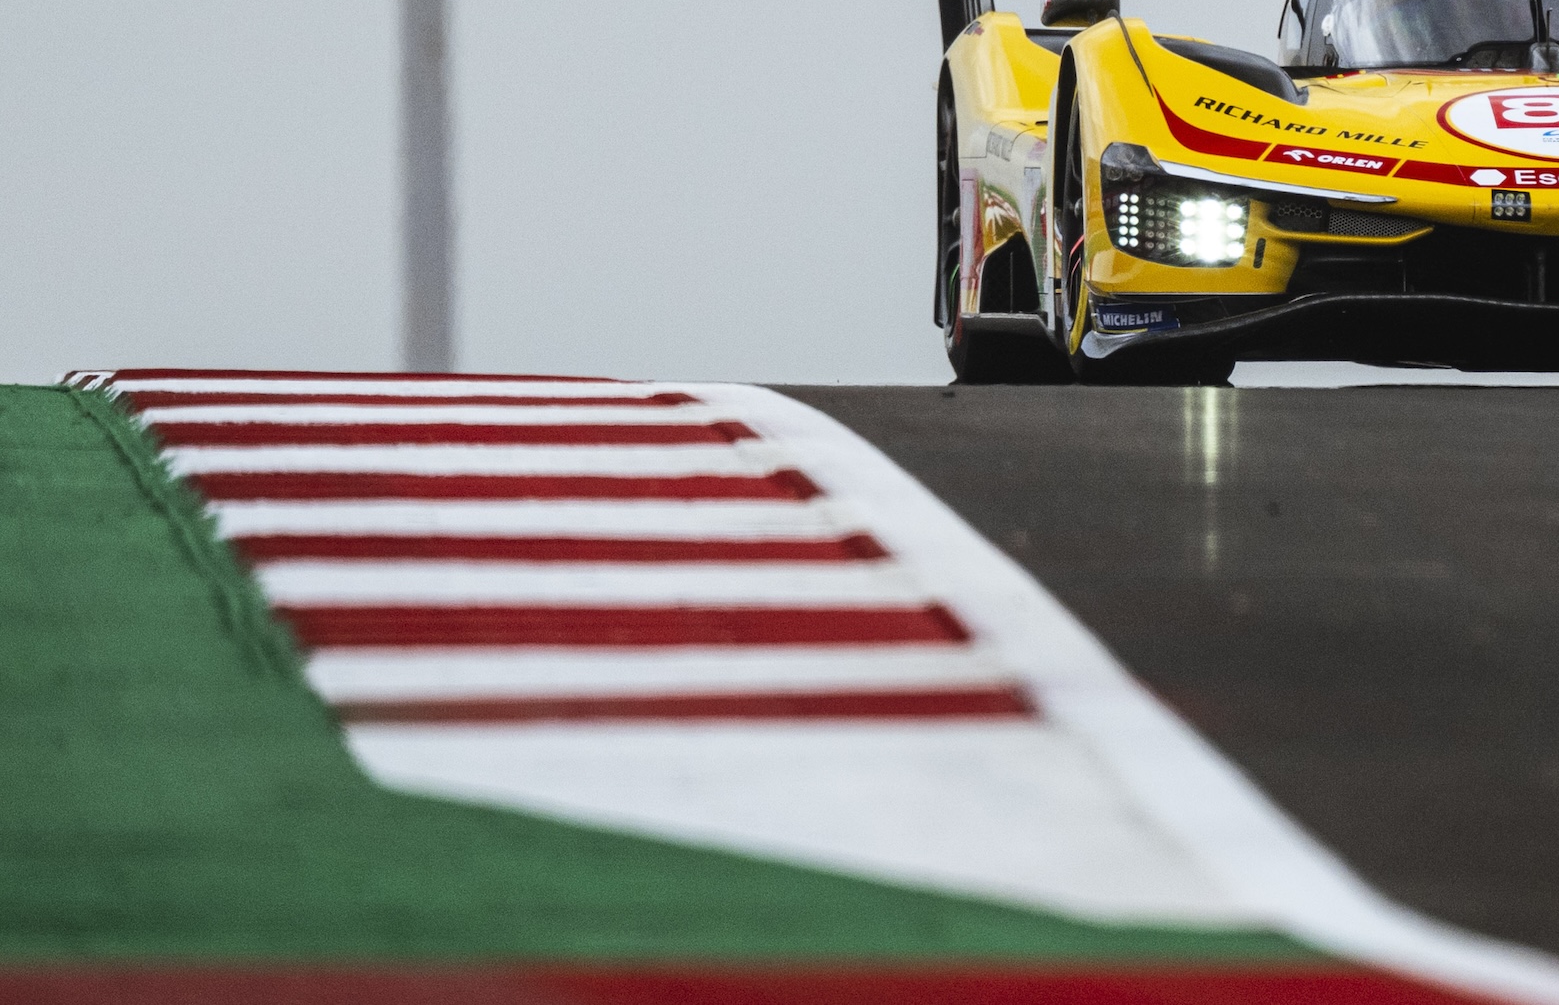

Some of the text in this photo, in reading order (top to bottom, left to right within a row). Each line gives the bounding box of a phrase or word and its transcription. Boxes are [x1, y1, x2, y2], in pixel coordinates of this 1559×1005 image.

[1194, 96, 1429, 150] RICHARD MILLE
[1317, 154, 1383, 170] ORLEN
[1102, 310, 1163, 326] MICHELIN
